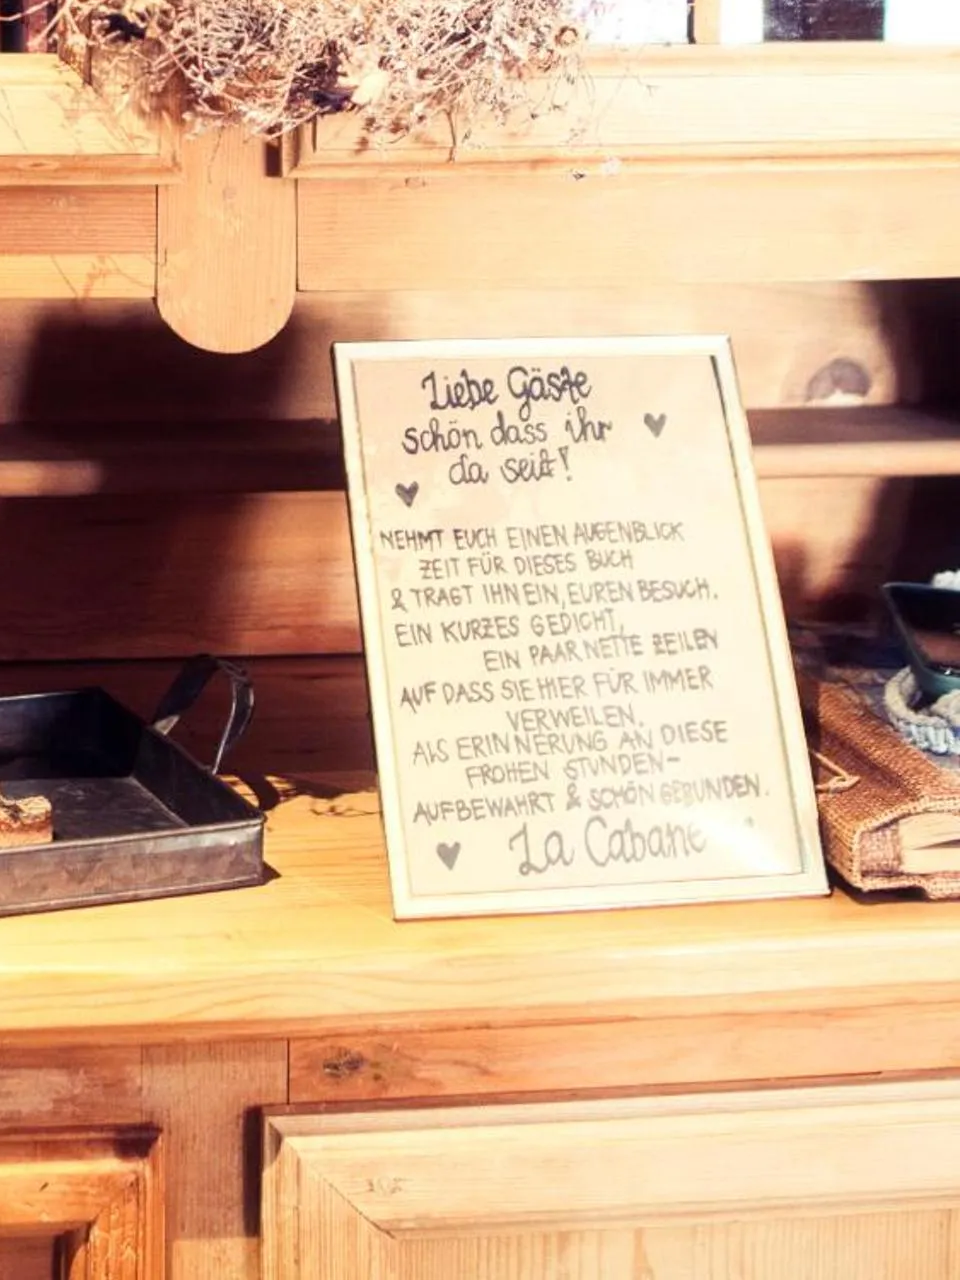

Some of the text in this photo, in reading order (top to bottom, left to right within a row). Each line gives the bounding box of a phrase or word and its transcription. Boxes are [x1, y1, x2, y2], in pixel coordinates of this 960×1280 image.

[421, 365, 593, 423] Liebe Gäste
[401, 405, 613, 455] schön dass ihr
[448, 453, 490, 485] da
[379, 520, 685, 552] NEHMT EUCH EINEN AUGENBLICK
[418, 548, 634, 580] ZEIT FÜR DIESES BUCH
[391, 587, 408, 613] &
[409, 584, 474, 609] TRAGT
[482, 583, 521, 606] IHN
[566, 579, 635, 605] EUREN
[636, 576, 719, 604] BESUCH.
[394, 621, 433, 647] EIN
[440, 614, 520, 645] KURZES
[482, 627, 720, 672] EIN PAAR NETTE ZEILEN
[399, 680, 437, 715] AUF
[442, 680, 495, 706] DASS
[500, 677, 536, 703] SIE
[592, 666, 639, 698] FÜR
[642, 664, 714, 695] IMMER
[505, 702, 645, 733] VERWEILEN.
[413, 718, 728, 767] ALS ERINNERUNG AN DIESE
[464, 759, 551, 790] FROHEN
[412, 790, 556, 826] AUFBEWAHRT
[565, 781, 582, 811] &
[588, 780, 655, 812] SCHÖN
[508, 815, 707, 877] La Cabane
